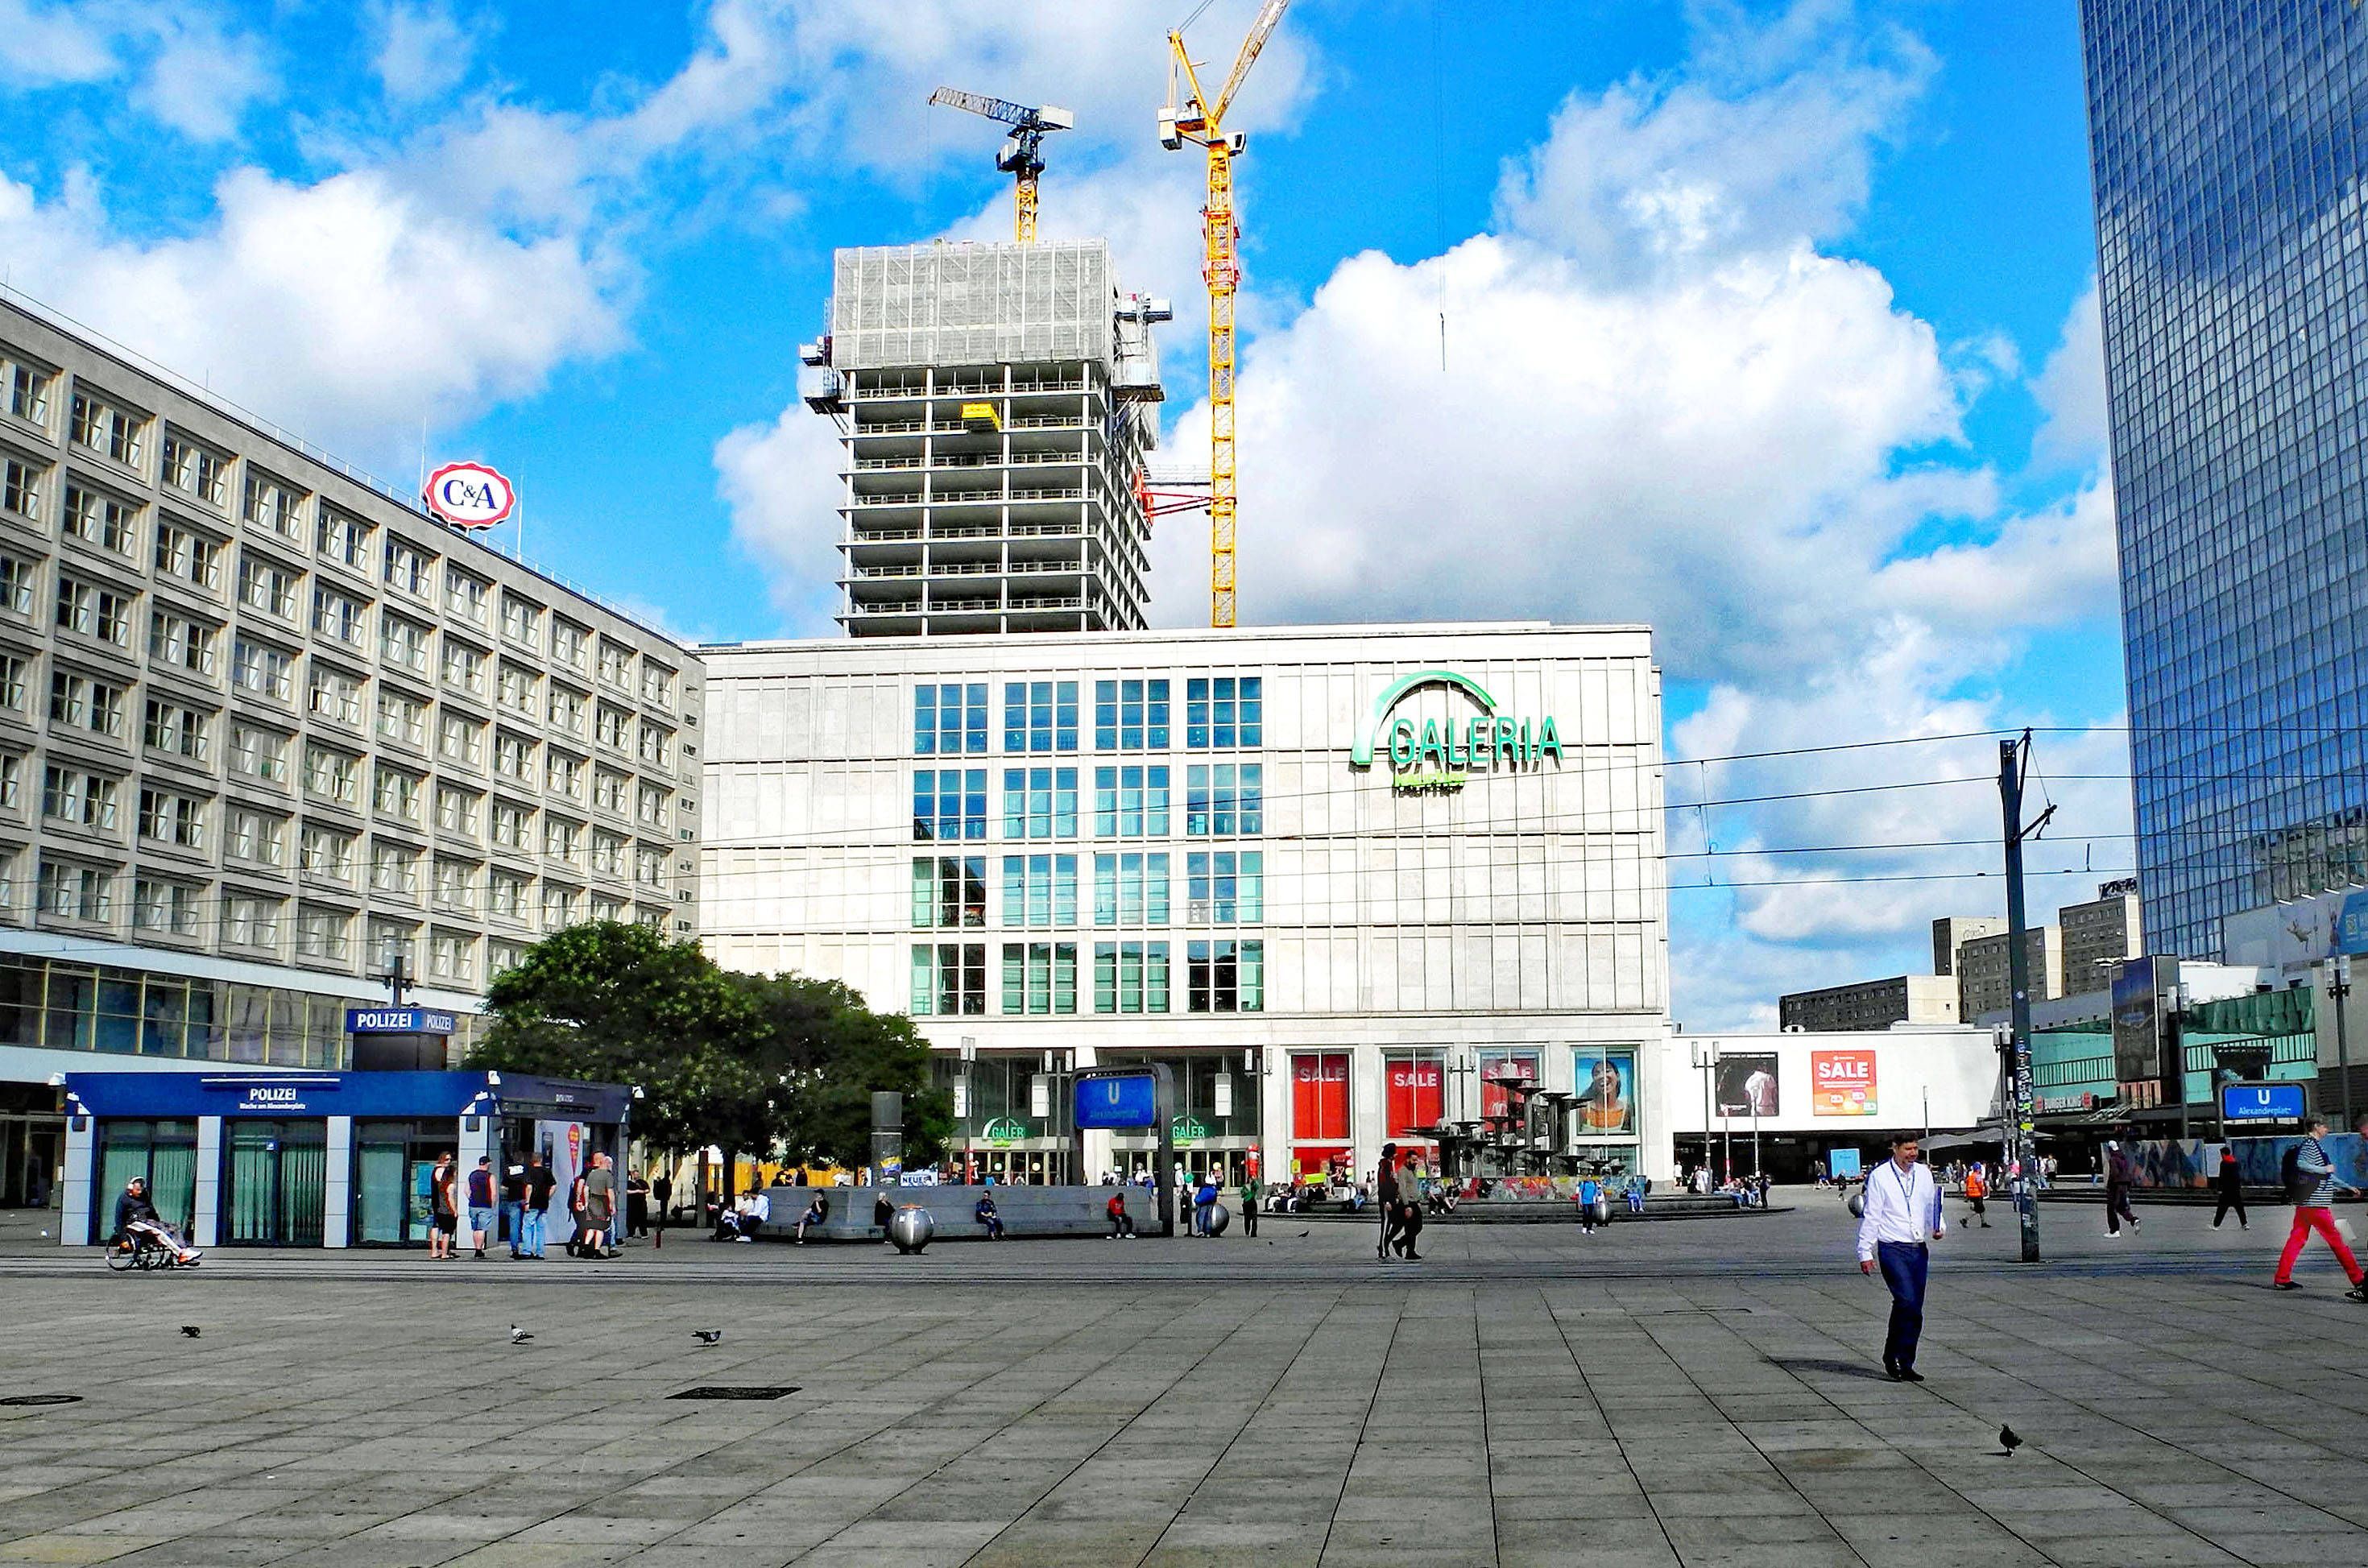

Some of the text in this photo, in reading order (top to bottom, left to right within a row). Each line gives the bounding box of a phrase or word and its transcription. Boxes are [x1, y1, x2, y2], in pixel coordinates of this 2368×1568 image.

[443, 479, 498, 509] C&A
[1390, 716, 1565, 764] GALERIA
[357, 1013, 412, 1028] POLIZEI
[426, 1015, 452, 1031] POLIZEI
[1299, 1067, 1346, 1082] SALE
[1487, 1066, 1532, 1079] SE
[1818, 1061, 1869, 1078] SALE
[1394, 1073, 1438, 1087] SALE
[249, 1088, 296, 1101] POLIZEI
[1108, 1082, 1120, 1105] U
[2257, 1089, 2271, 1105] U
